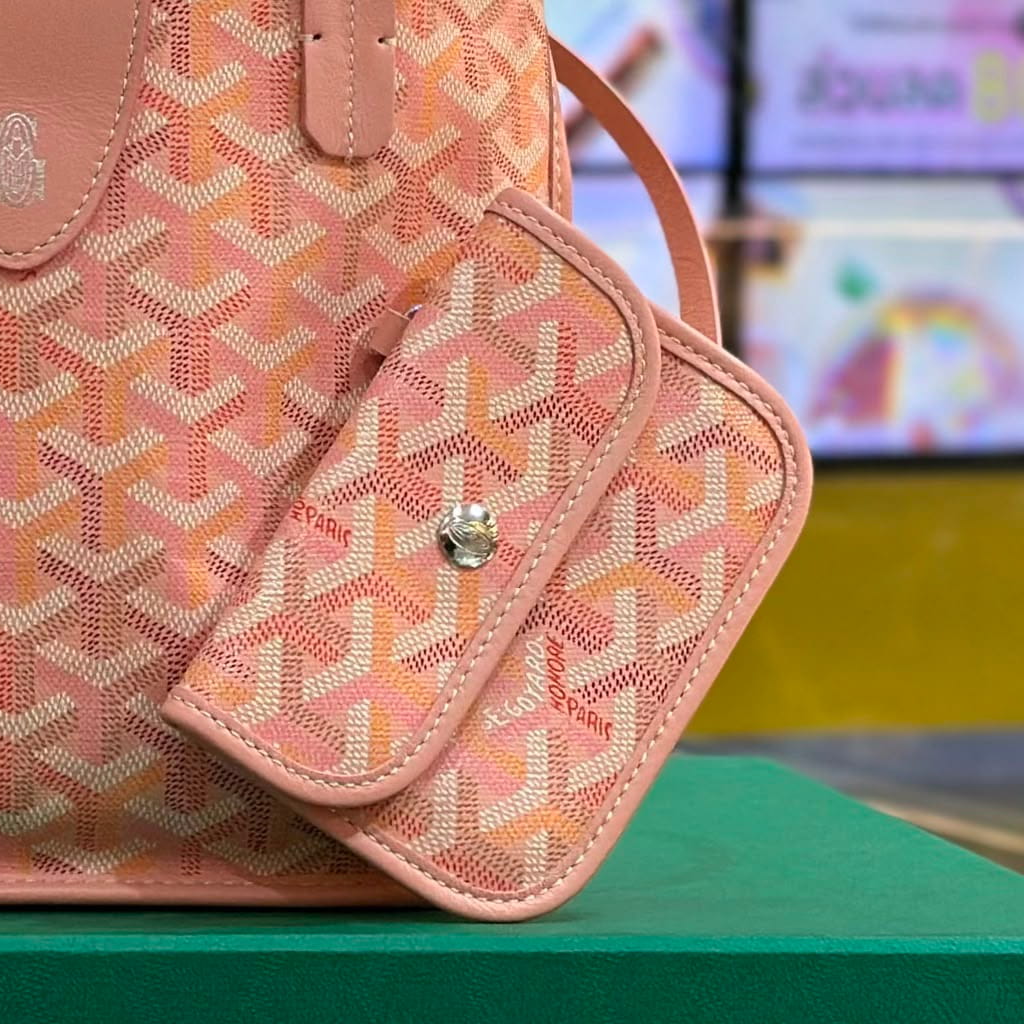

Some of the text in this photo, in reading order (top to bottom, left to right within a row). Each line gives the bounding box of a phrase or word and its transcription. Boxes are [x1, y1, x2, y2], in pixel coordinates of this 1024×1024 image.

[305, 505, 352, 548] PARIS
[545, 631, 566, 713] HONORE
[567, 697, 613, 741] PARIS
